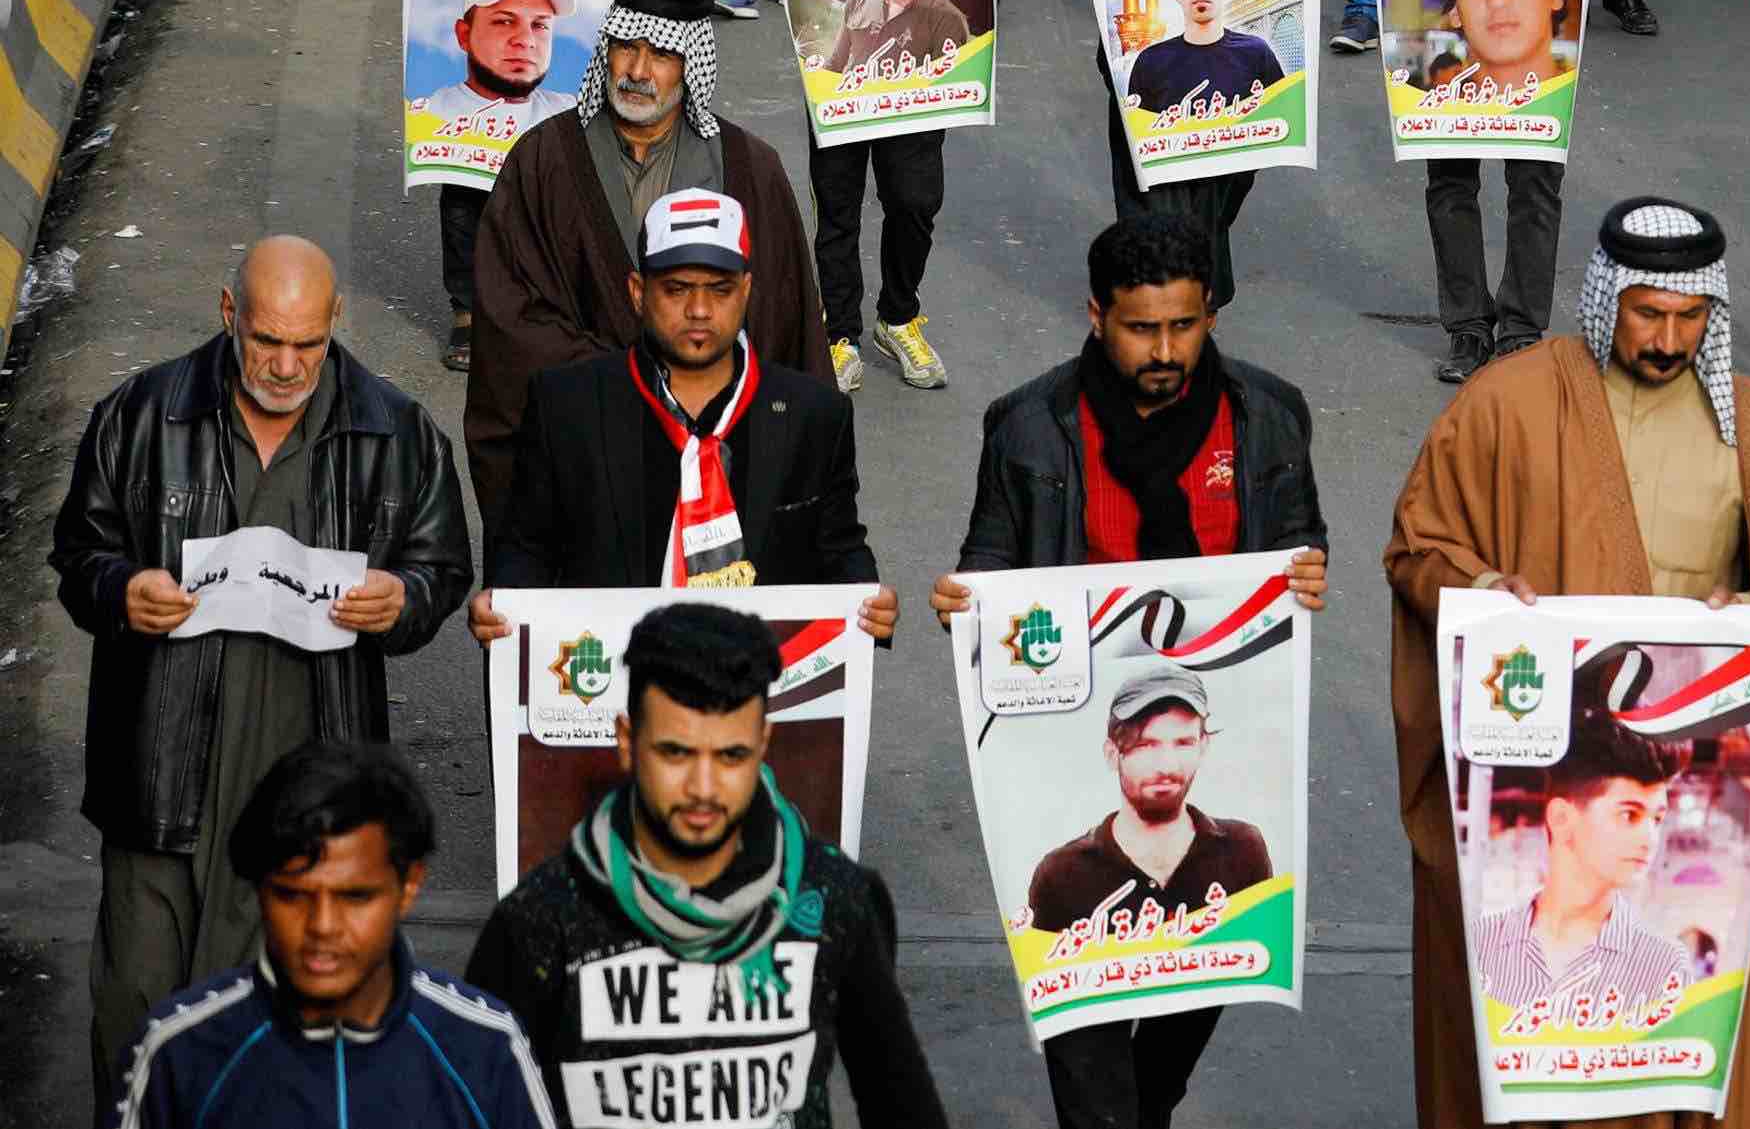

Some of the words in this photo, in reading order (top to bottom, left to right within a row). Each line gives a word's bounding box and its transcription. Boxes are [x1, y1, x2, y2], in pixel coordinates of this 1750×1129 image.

[257, 560, 340, 604] المرجعية
[1157, 953, 1207, 974] اغاثة
[1210, 950, 1256, 970] وحدة
[1030, 971, 1079, 1001] الاعلام
[1095, 964, 1126, 989] قار
[1130, 961, 1153, 987] ذي
[603, 960, 681, 1026] WE
[1546, 1050, 1580, 1075] قار
[1583, 1049, 1606, 1079] ذي
[1610, 1045, 1655, 1070] اغاثة
[1658, 1045, 1702, 1071] وحدة
[593, 1051, 793, 1124] LEGENDS
